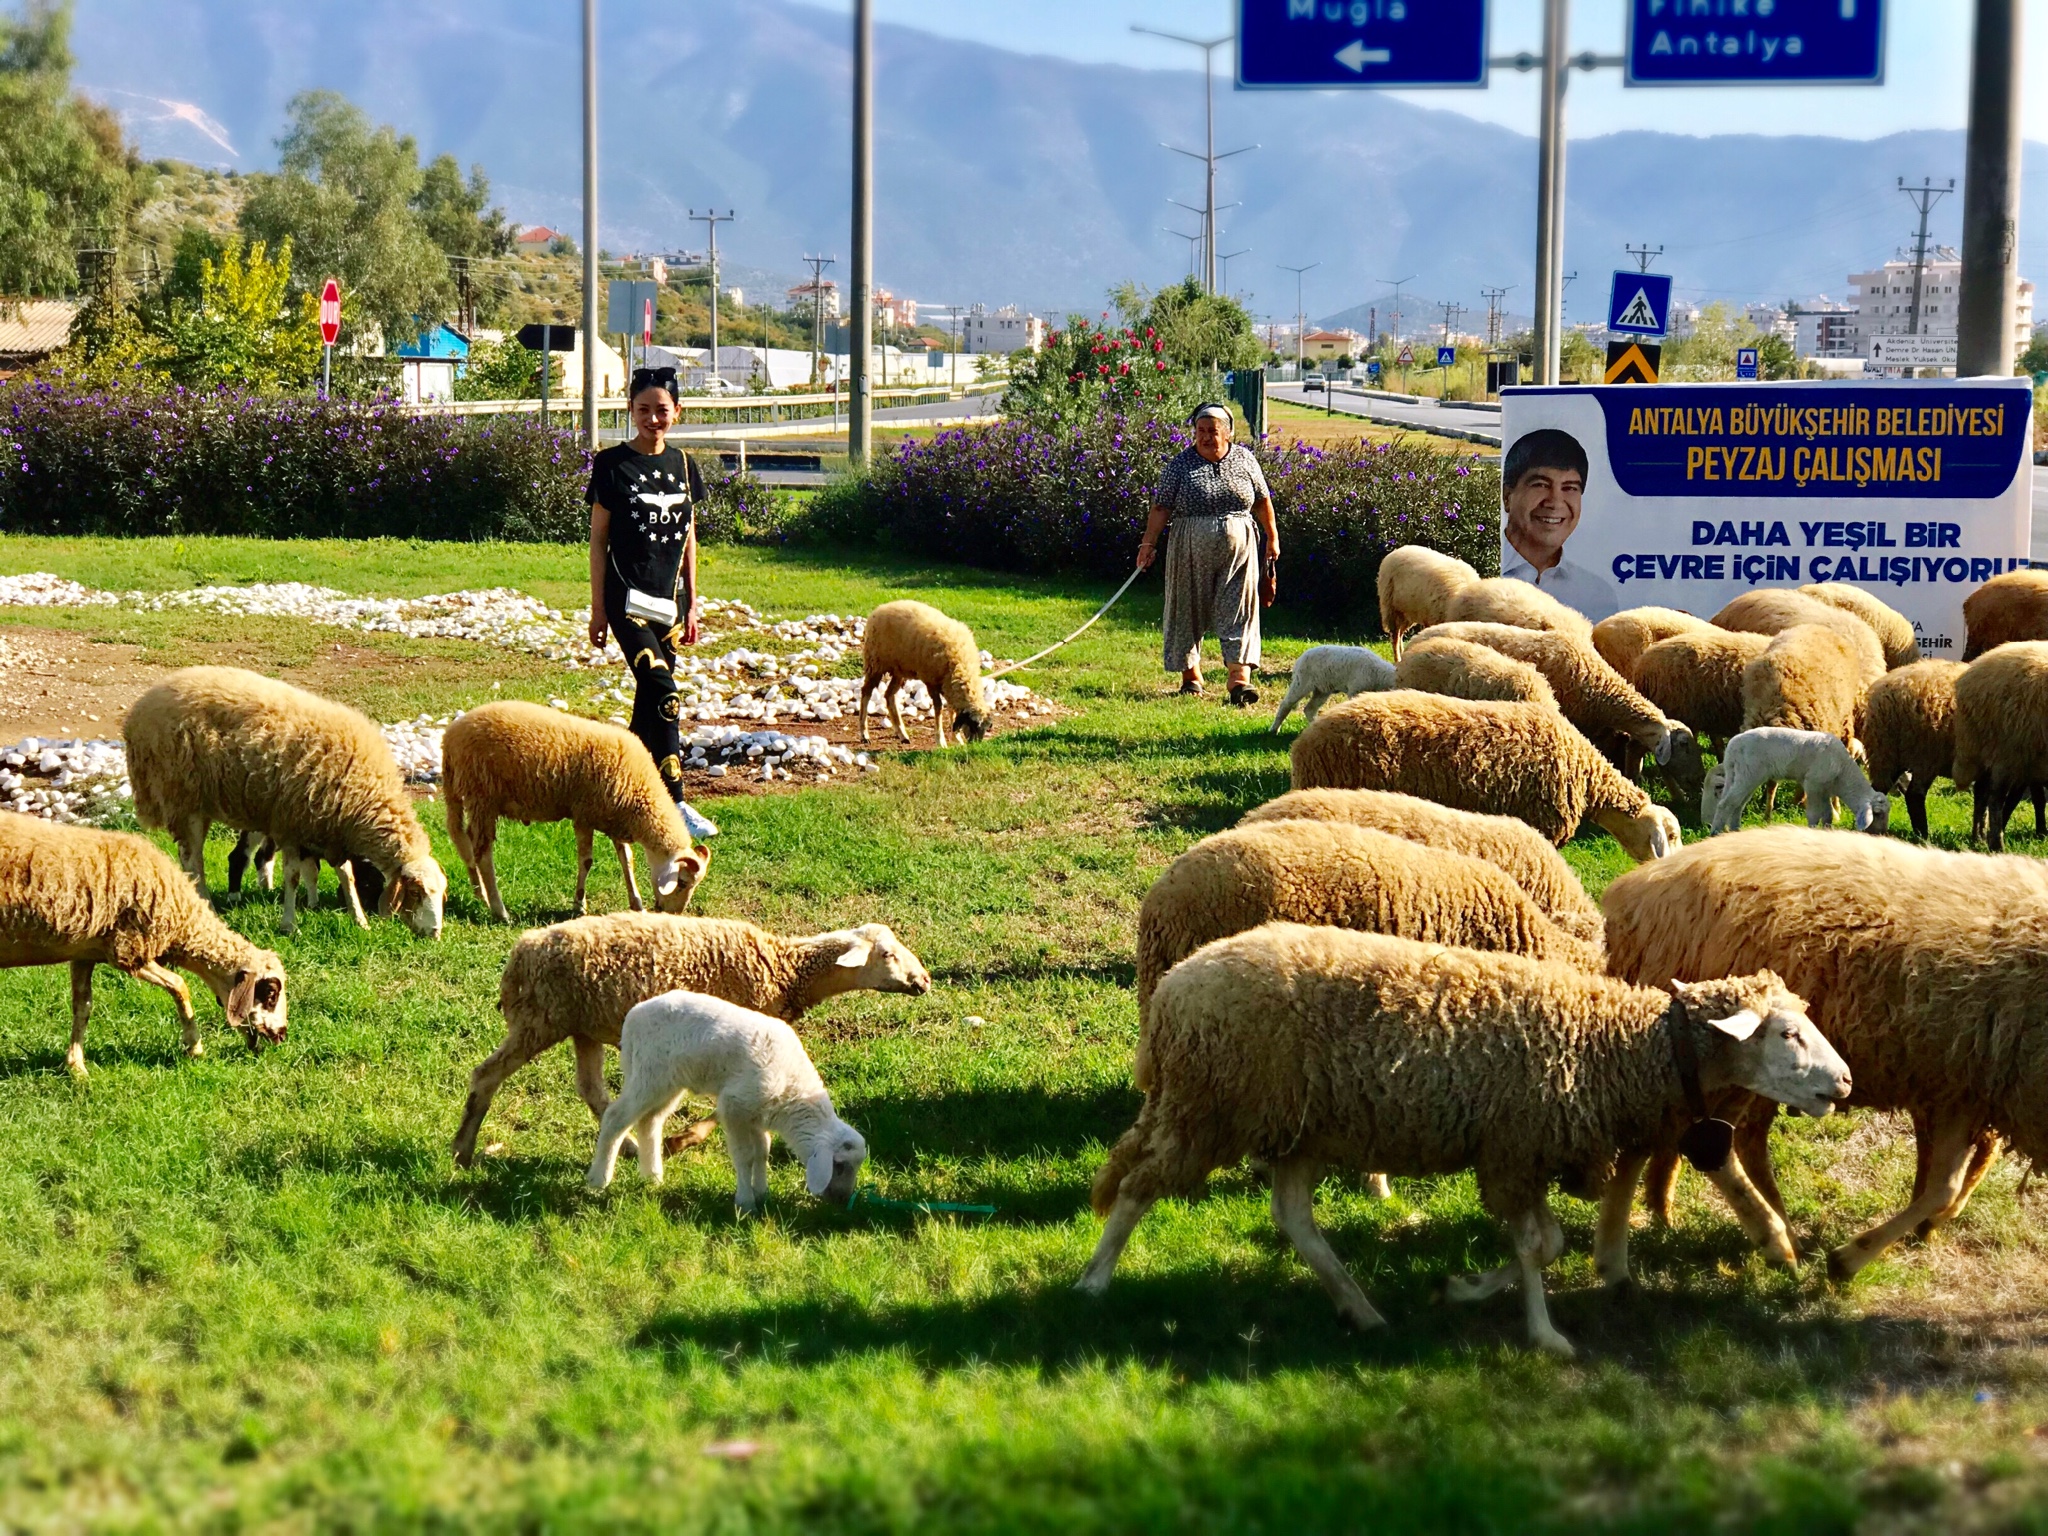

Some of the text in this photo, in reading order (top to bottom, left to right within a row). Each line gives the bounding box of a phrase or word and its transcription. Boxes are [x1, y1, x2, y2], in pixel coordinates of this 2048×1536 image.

[1649, 30, 1802, 62] Antalya
[322, 300, 338, 325] DUR
[1945, 345, 1957, 354] ÜN
[1628, 402, 2005, 441] ANTALYA BÜYÜKŞEHİR BELEDİYESİ
[1687, 446, 1942, 488] PEYZAJ ÇALIŞMASI
[649, 511, 682, 524] BOY
[1692, 520, 1961, 552] DAHA YEŞİL BİR
[1612, 553, 1725, 584] ÇEVRE
[1733, 554, 1801, 585] İÇİN
